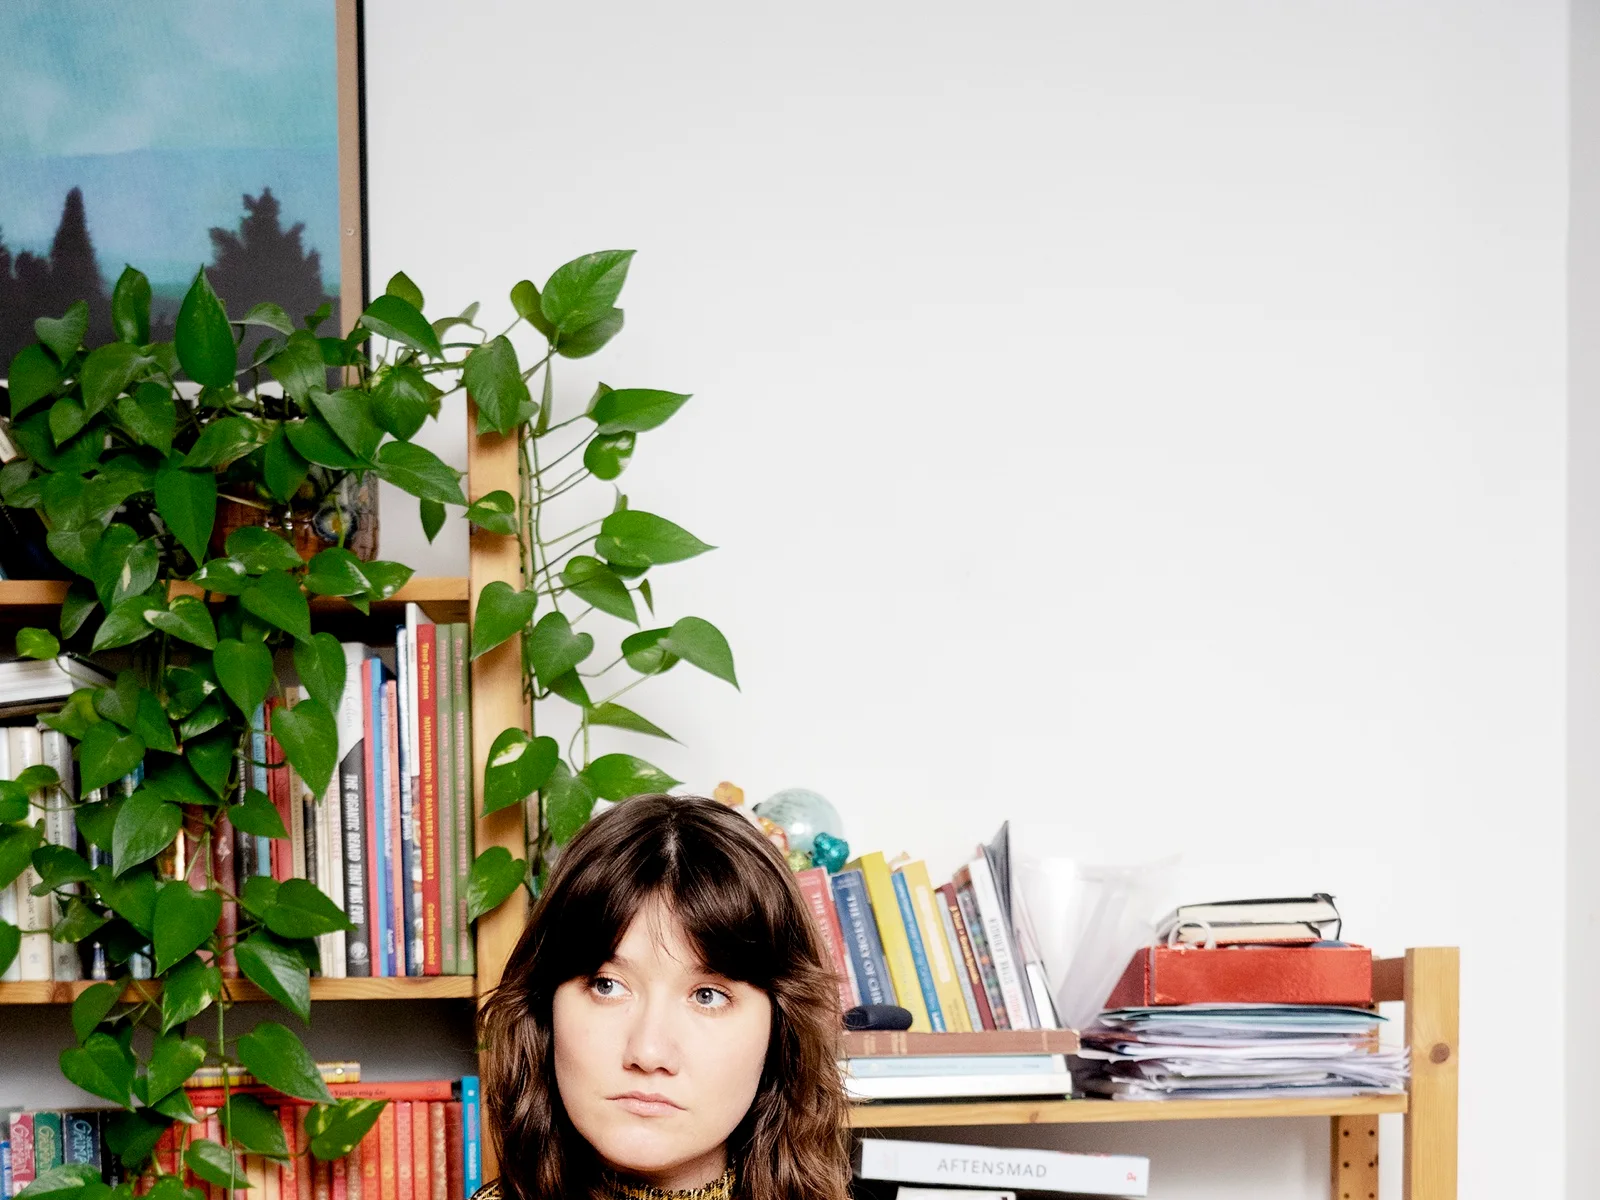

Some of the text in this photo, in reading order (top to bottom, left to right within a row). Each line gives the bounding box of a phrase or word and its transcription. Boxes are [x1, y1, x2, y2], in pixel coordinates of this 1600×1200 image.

[344, 773, 359, 790] THE
[424, 785, 433, 797] DE
[345, 792, 360, 829] GIGANTIC
[424, 798, 434, 837] SAMLEDE
[347, 831, 361, 862] BEARD
[425, 838, 435, 873] STRIBER
[348, 863, 362, 885] THAT
[349, 886, 362, 903] WAS
[852, 919, 871, 959] STORY
[937, 1157, 1048, 1178] AFTENSMAD
